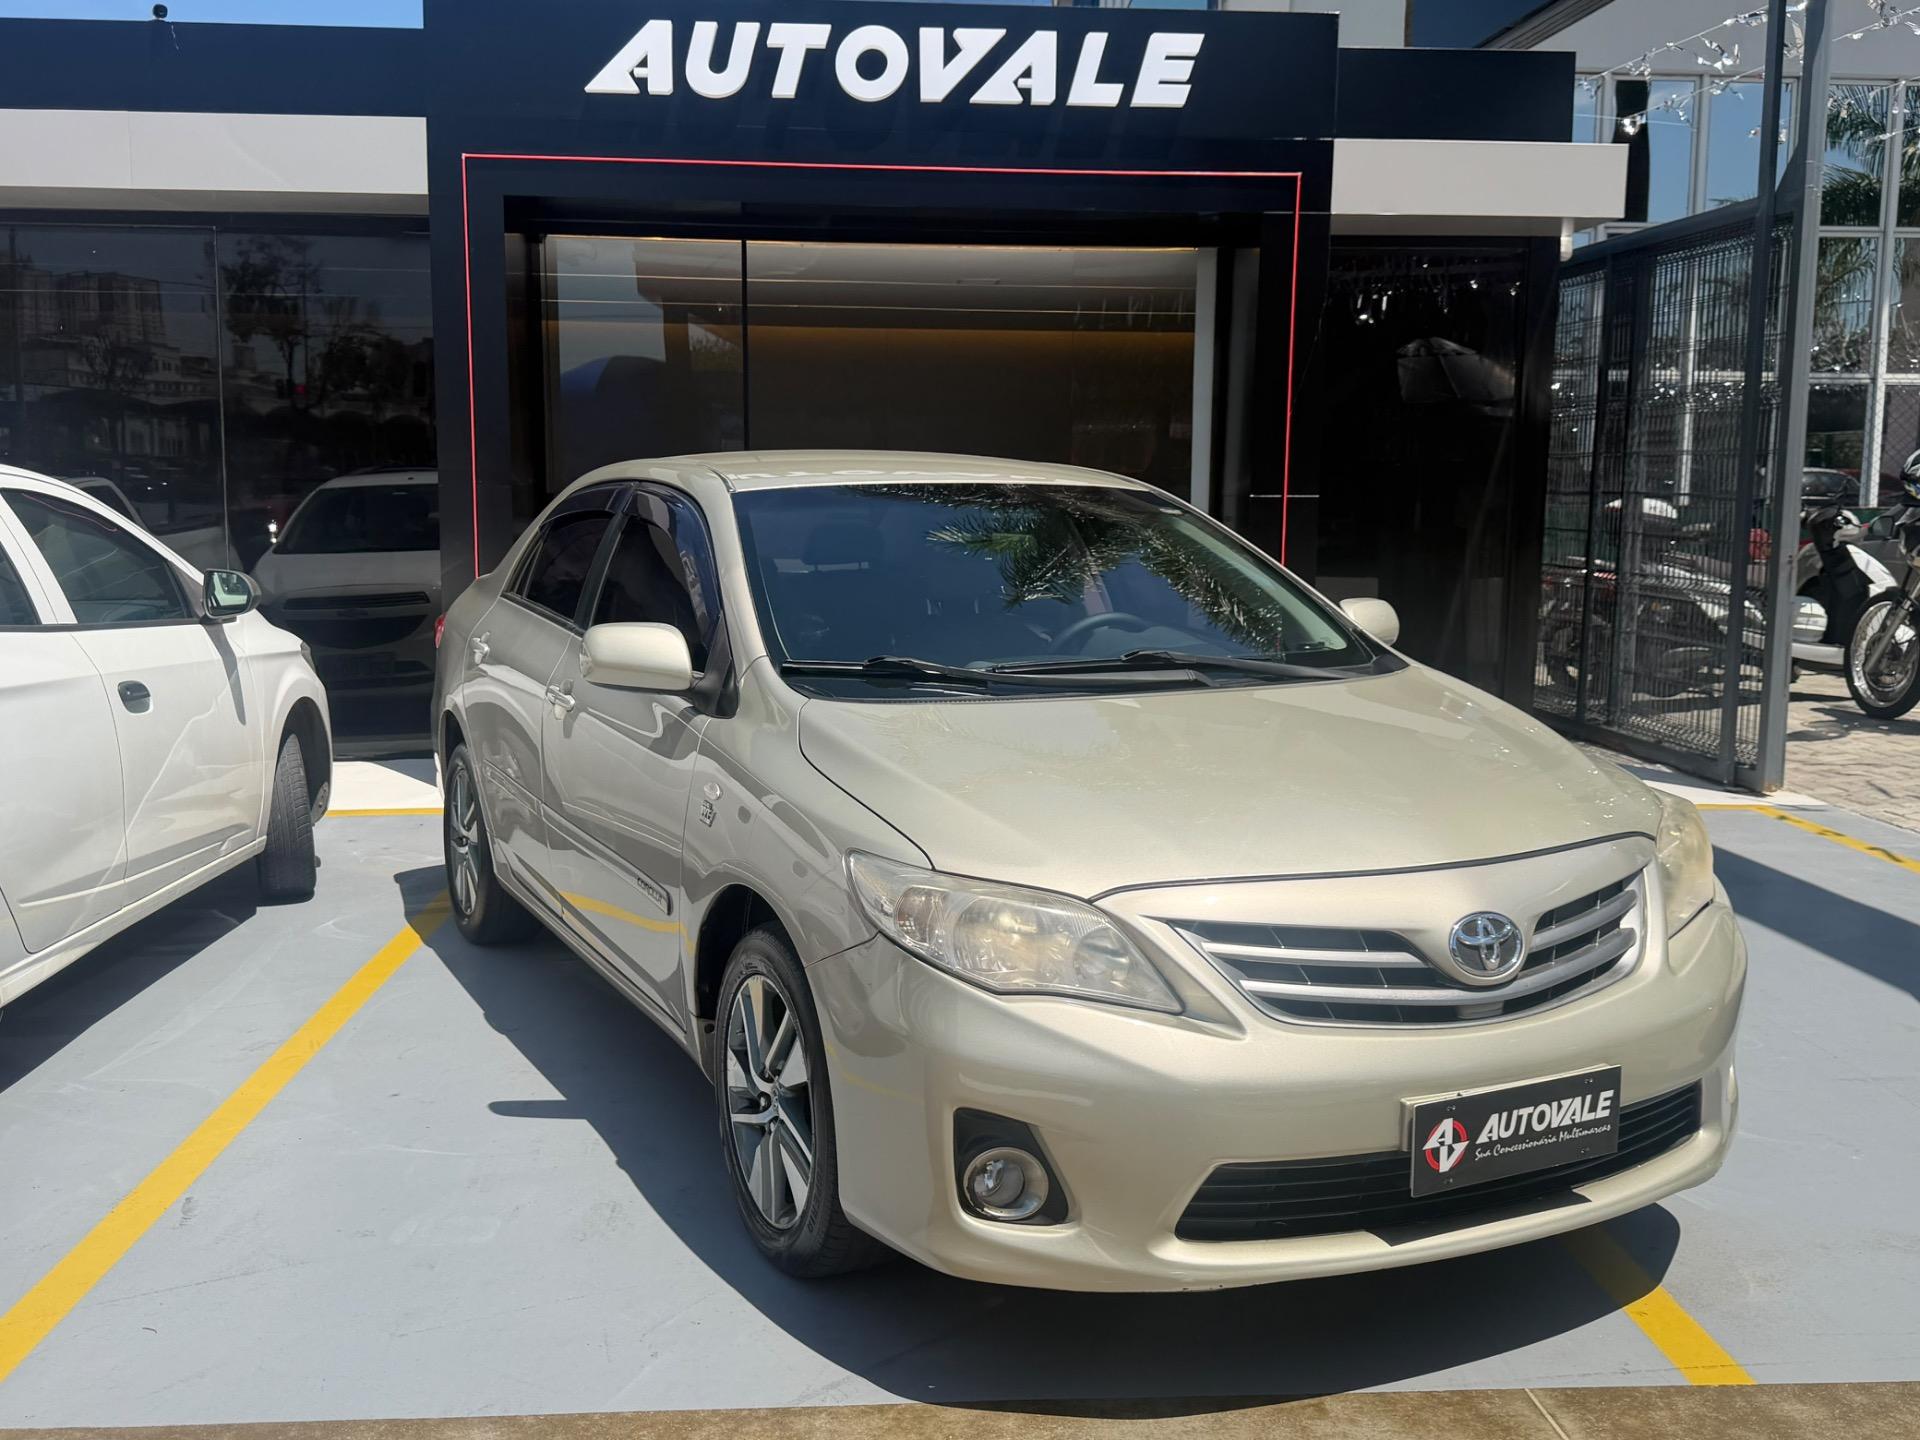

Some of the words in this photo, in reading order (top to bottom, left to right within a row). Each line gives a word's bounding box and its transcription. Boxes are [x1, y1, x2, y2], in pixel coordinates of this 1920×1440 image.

[584, 19, 1206, 108] AUTOVALE
[1475, 1089, 1615, 1144] AUTOVALE
[1475, 1148, 1491, 1160] Sua
[1559, 1124, 1611, 1142] Multimarcas
